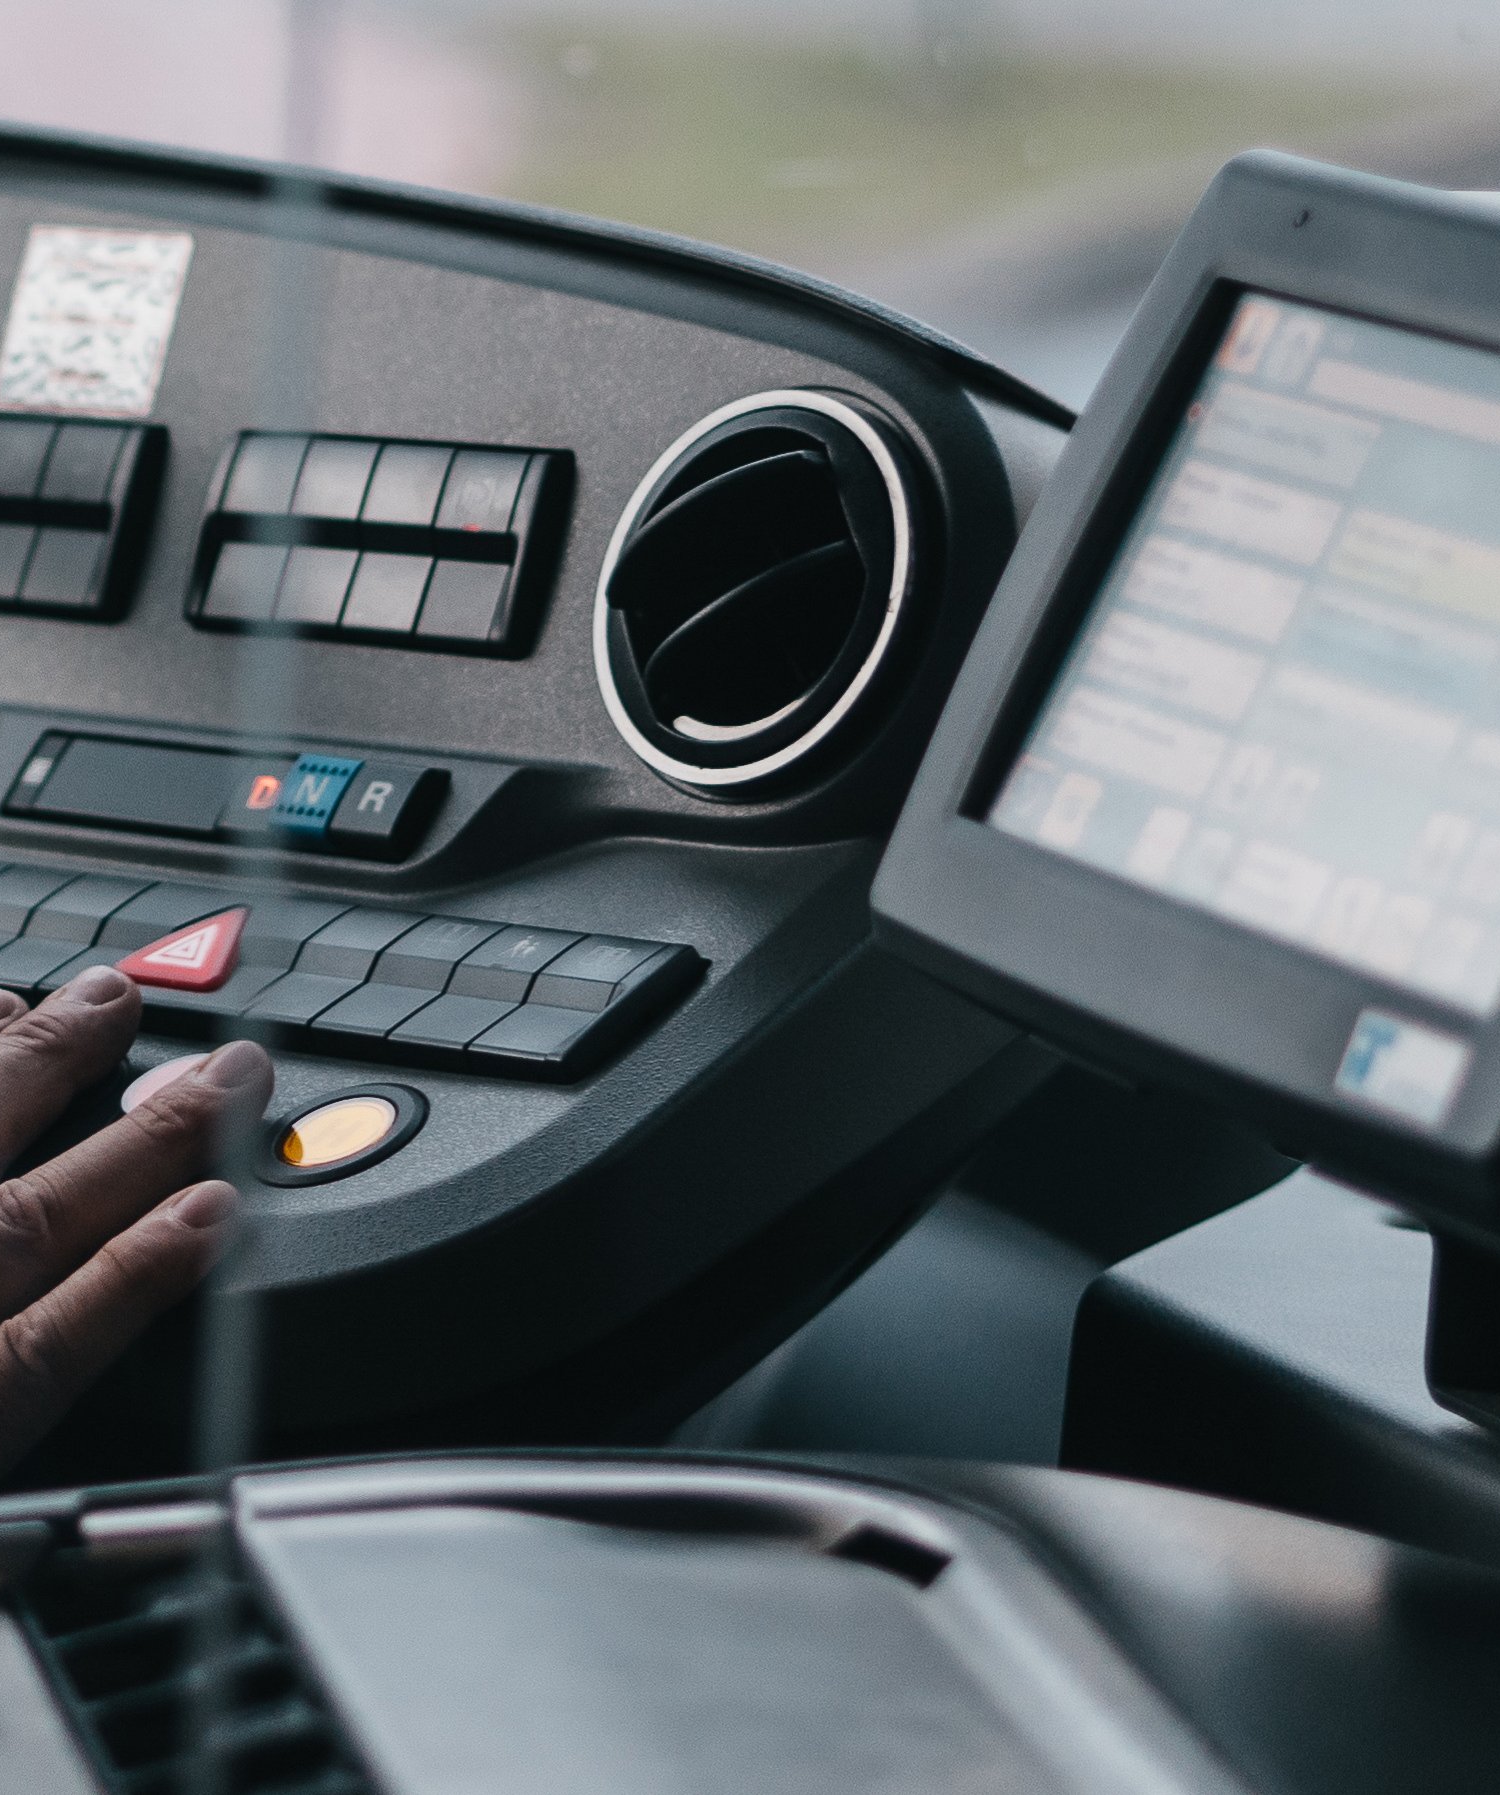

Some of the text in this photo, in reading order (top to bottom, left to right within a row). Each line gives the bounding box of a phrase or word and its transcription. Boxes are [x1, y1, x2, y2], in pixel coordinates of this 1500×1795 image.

[246, 774, 394, 812] D N R
